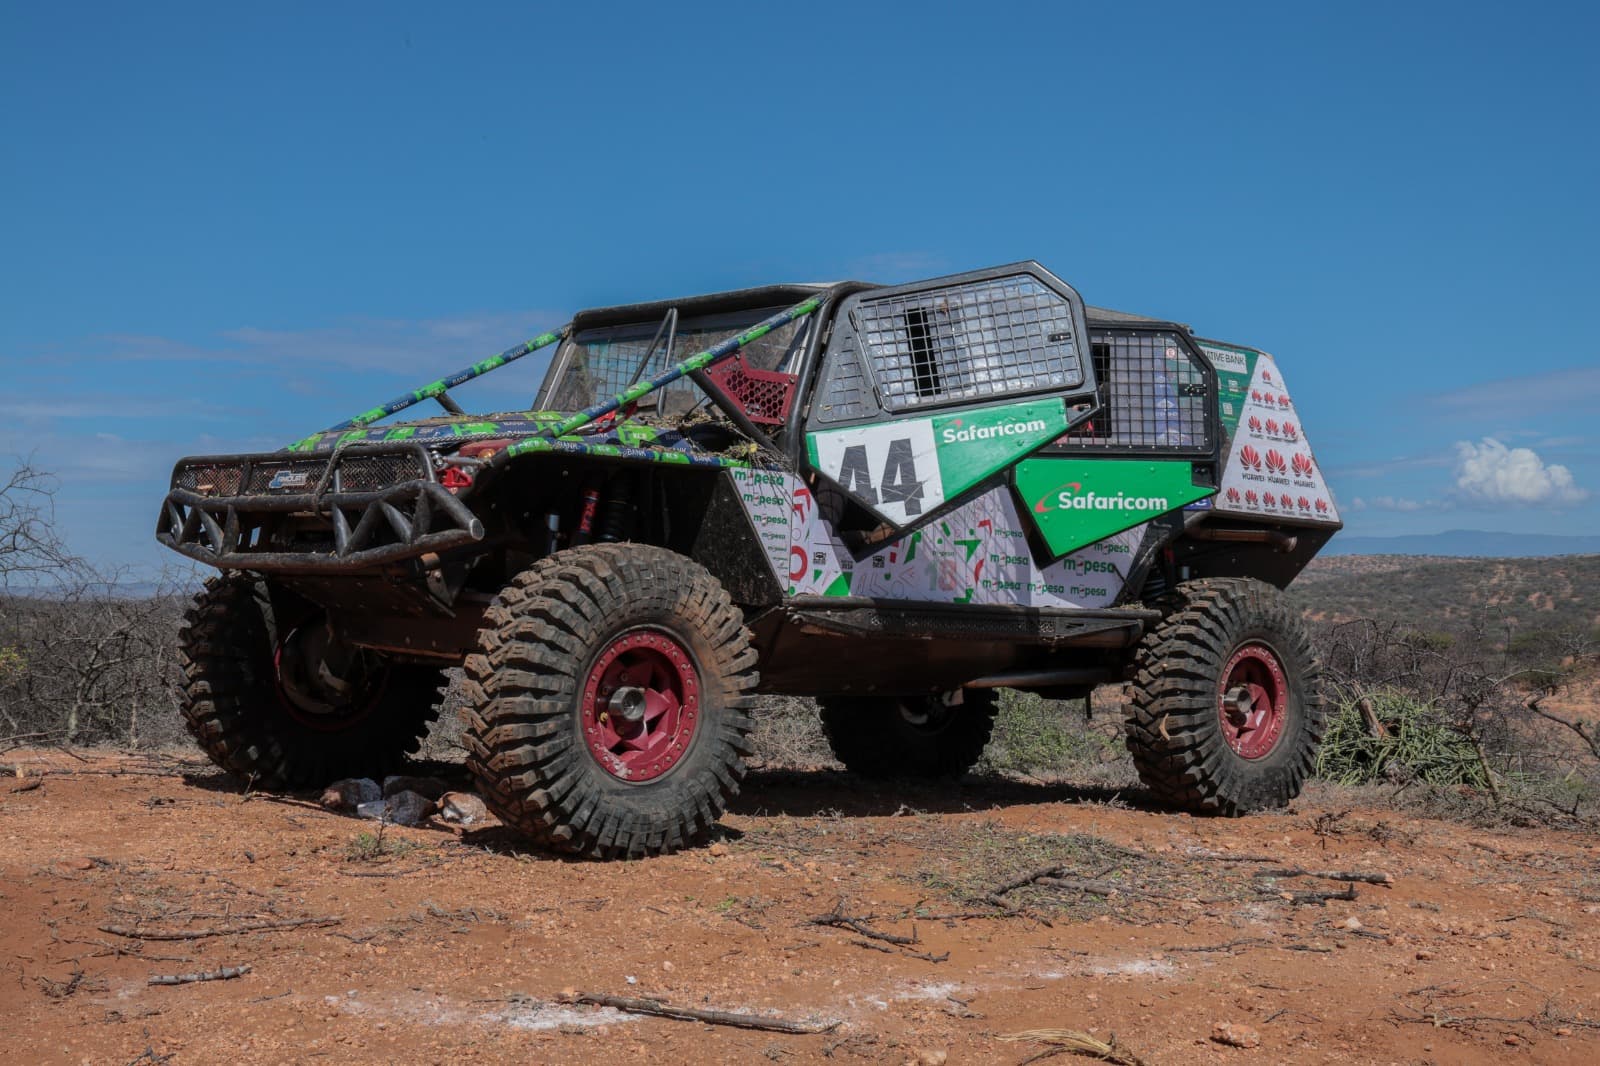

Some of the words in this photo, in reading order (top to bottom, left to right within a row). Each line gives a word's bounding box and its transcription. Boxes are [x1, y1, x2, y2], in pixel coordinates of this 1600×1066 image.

[1226, 353, 1246, 366] BANK
[943, 419, 1046, 443] Safaricom
[838, 438, 925, 516] 44
[1242, 472, 1265, 482] HUAWEI
[1267, 475, 1290, 486] HUAWEI
[1293, 480, 1316, 489] HUAWEI
[1057, 491, 1168, 511] Safaricom
